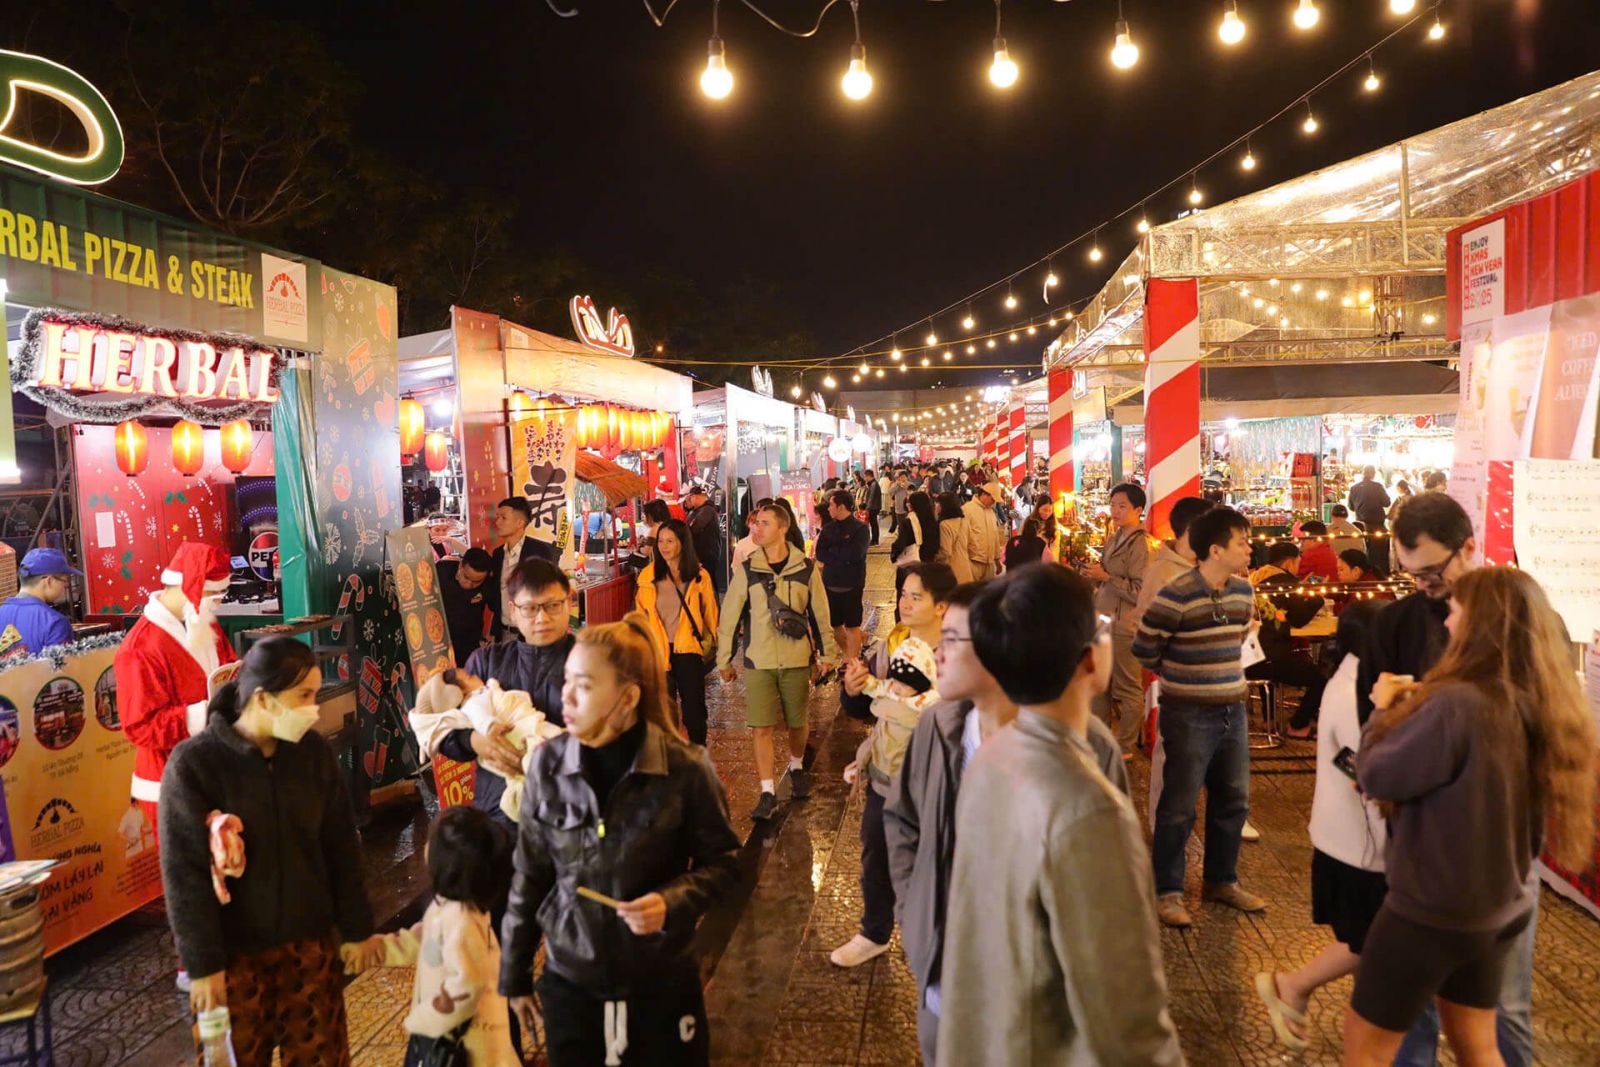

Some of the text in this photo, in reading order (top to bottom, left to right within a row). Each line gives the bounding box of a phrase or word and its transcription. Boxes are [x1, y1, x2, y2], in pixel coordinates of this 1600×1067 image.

[1470, 235, 1489, 251] ENJOY
[1470, 248, 1489, 263] XMAS
[84, 231, 160, 289] PIZZA
[167, 255, 183, 295] &
[191, 260, 254, 309] STEAK
[1484, 256, 1503, 272] YEAR
[1470, 273, 1498, 288] FESTIVAL
[38, 320, 280, 402] HERBAL
[444, 780, 474, 807] 10%
